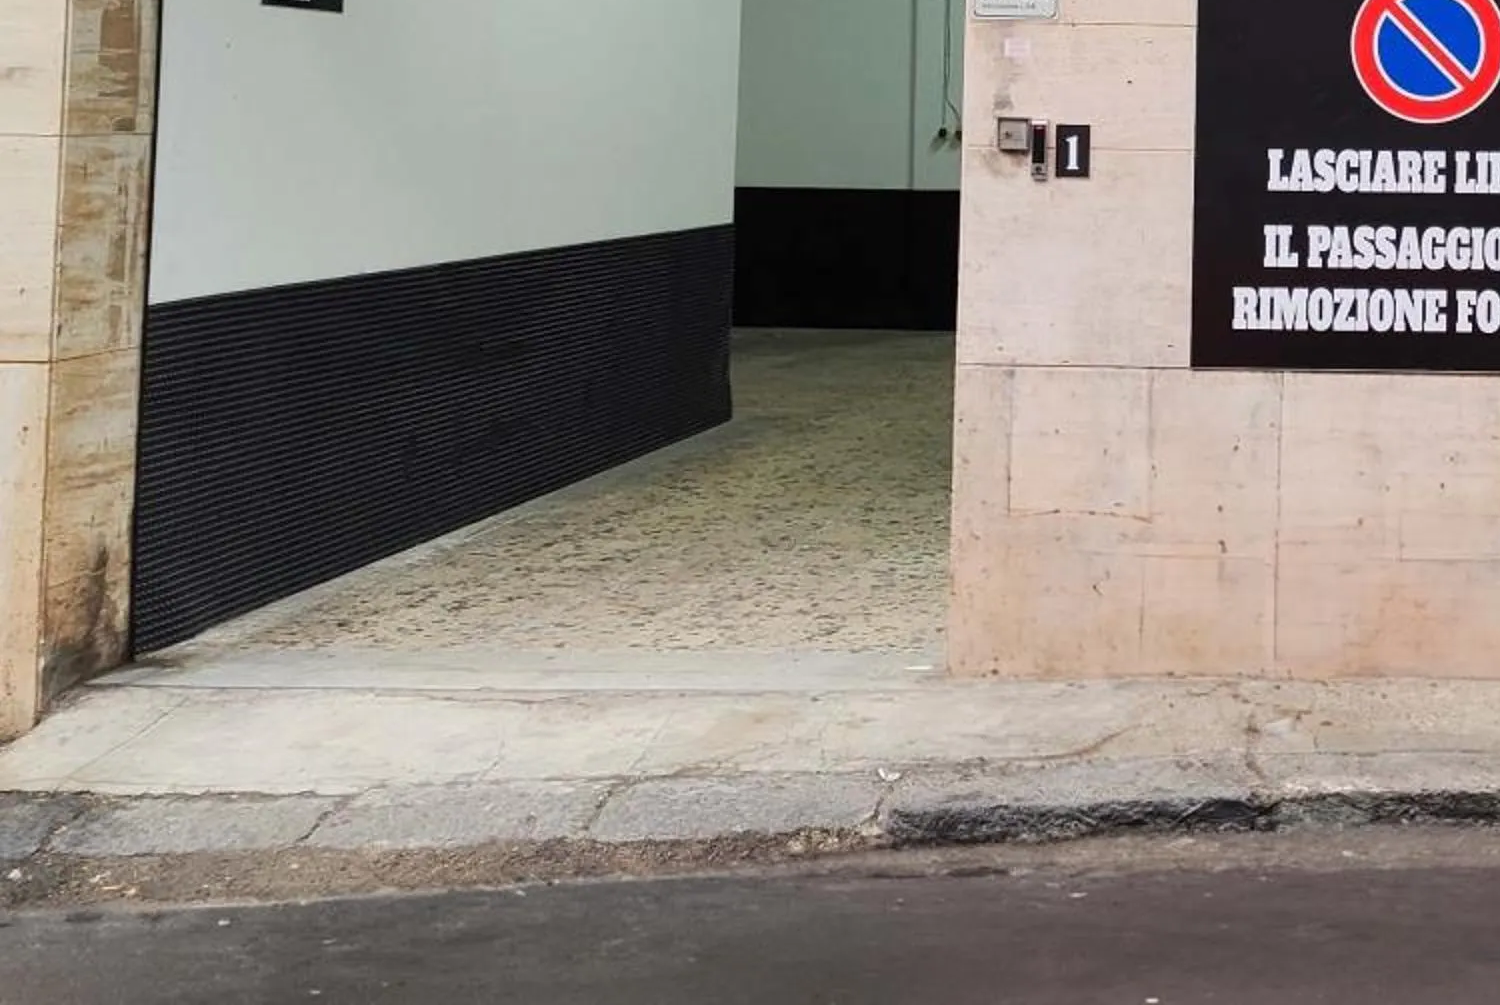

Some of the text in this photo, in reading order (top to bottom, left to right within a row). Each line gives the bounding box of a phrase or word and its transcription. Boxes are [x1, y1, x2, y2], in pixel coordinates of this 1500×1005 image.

[1065, 134, 1080, 170] 1
[1267, 148, 1447, 194] LASCIARE
[1263, 224, 1299, 268] IL
[1232, 286, 1448, 333] RIMOZIONE
